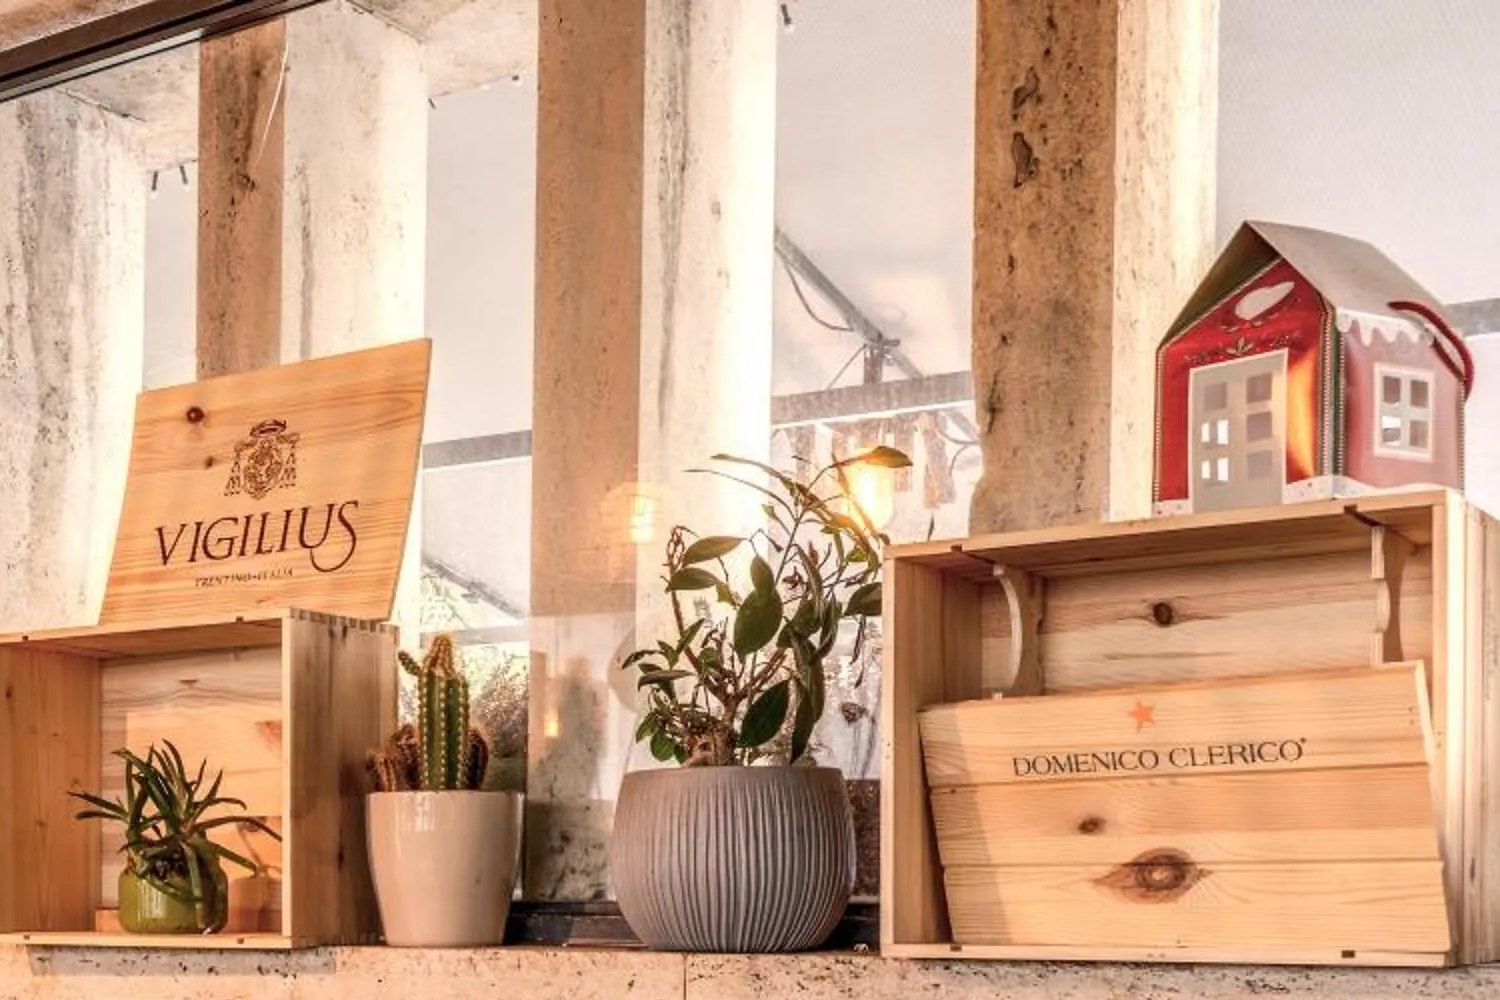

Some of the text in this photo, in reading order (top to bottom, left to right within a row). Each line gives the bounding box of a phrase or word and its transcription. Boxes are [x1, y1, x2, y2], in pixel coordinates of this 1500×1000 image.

[155, 500, 359, 573] VIGILIUS
[1012, 740, 1304, 777] DOMENICO CLERICO
